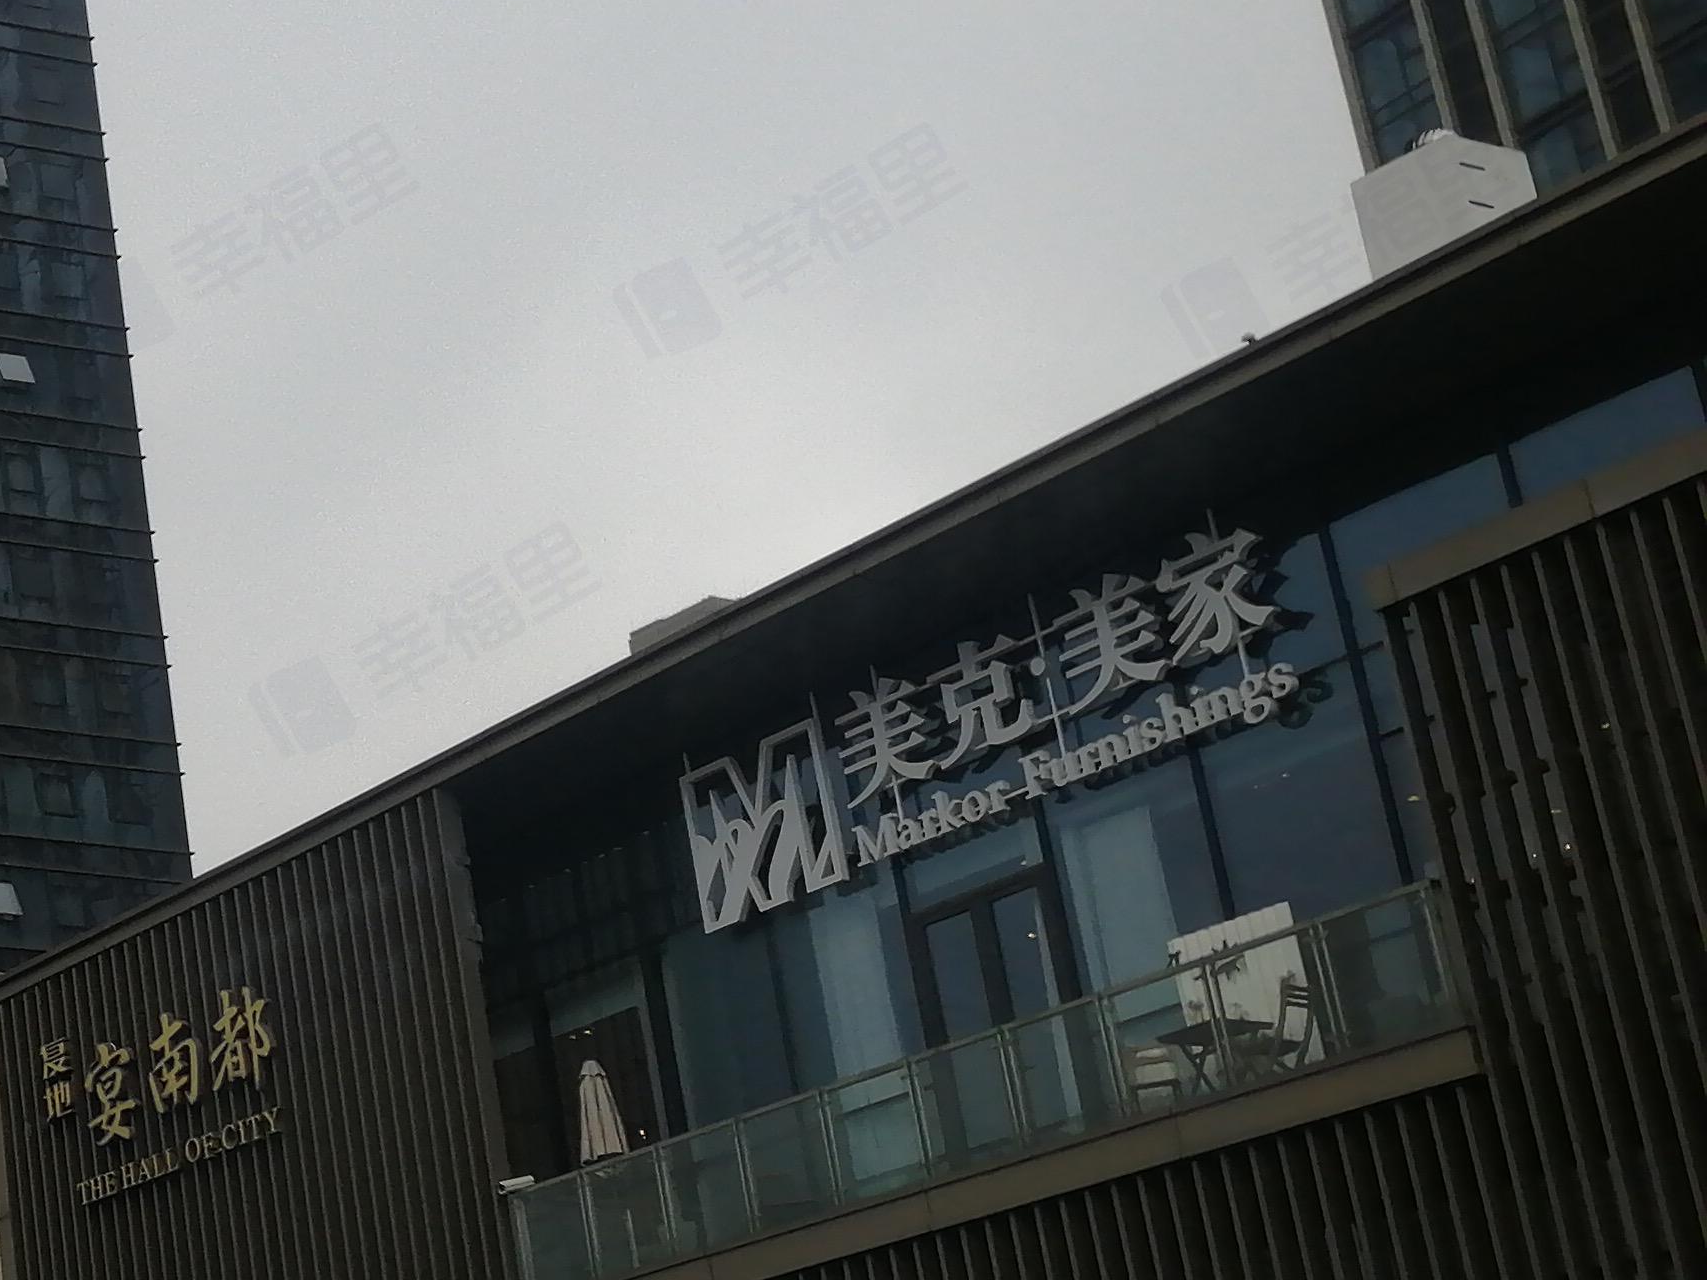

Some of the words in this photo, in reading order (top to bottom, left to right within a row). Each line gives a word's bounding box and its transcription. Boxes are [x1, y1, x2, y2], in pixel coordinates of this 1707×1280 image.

[851, 779, 1012, 868] Markor
[1019, 661, 1300, 800] Furnishings
[87, 986, 272, 1146] 宴南都
[77, 1171, 118, 1205] THE
[120, 1148, 179, 1191] HALL
[185, 1131, 215, 1163] OF
[221, 1107, 282, 1153] CITY
